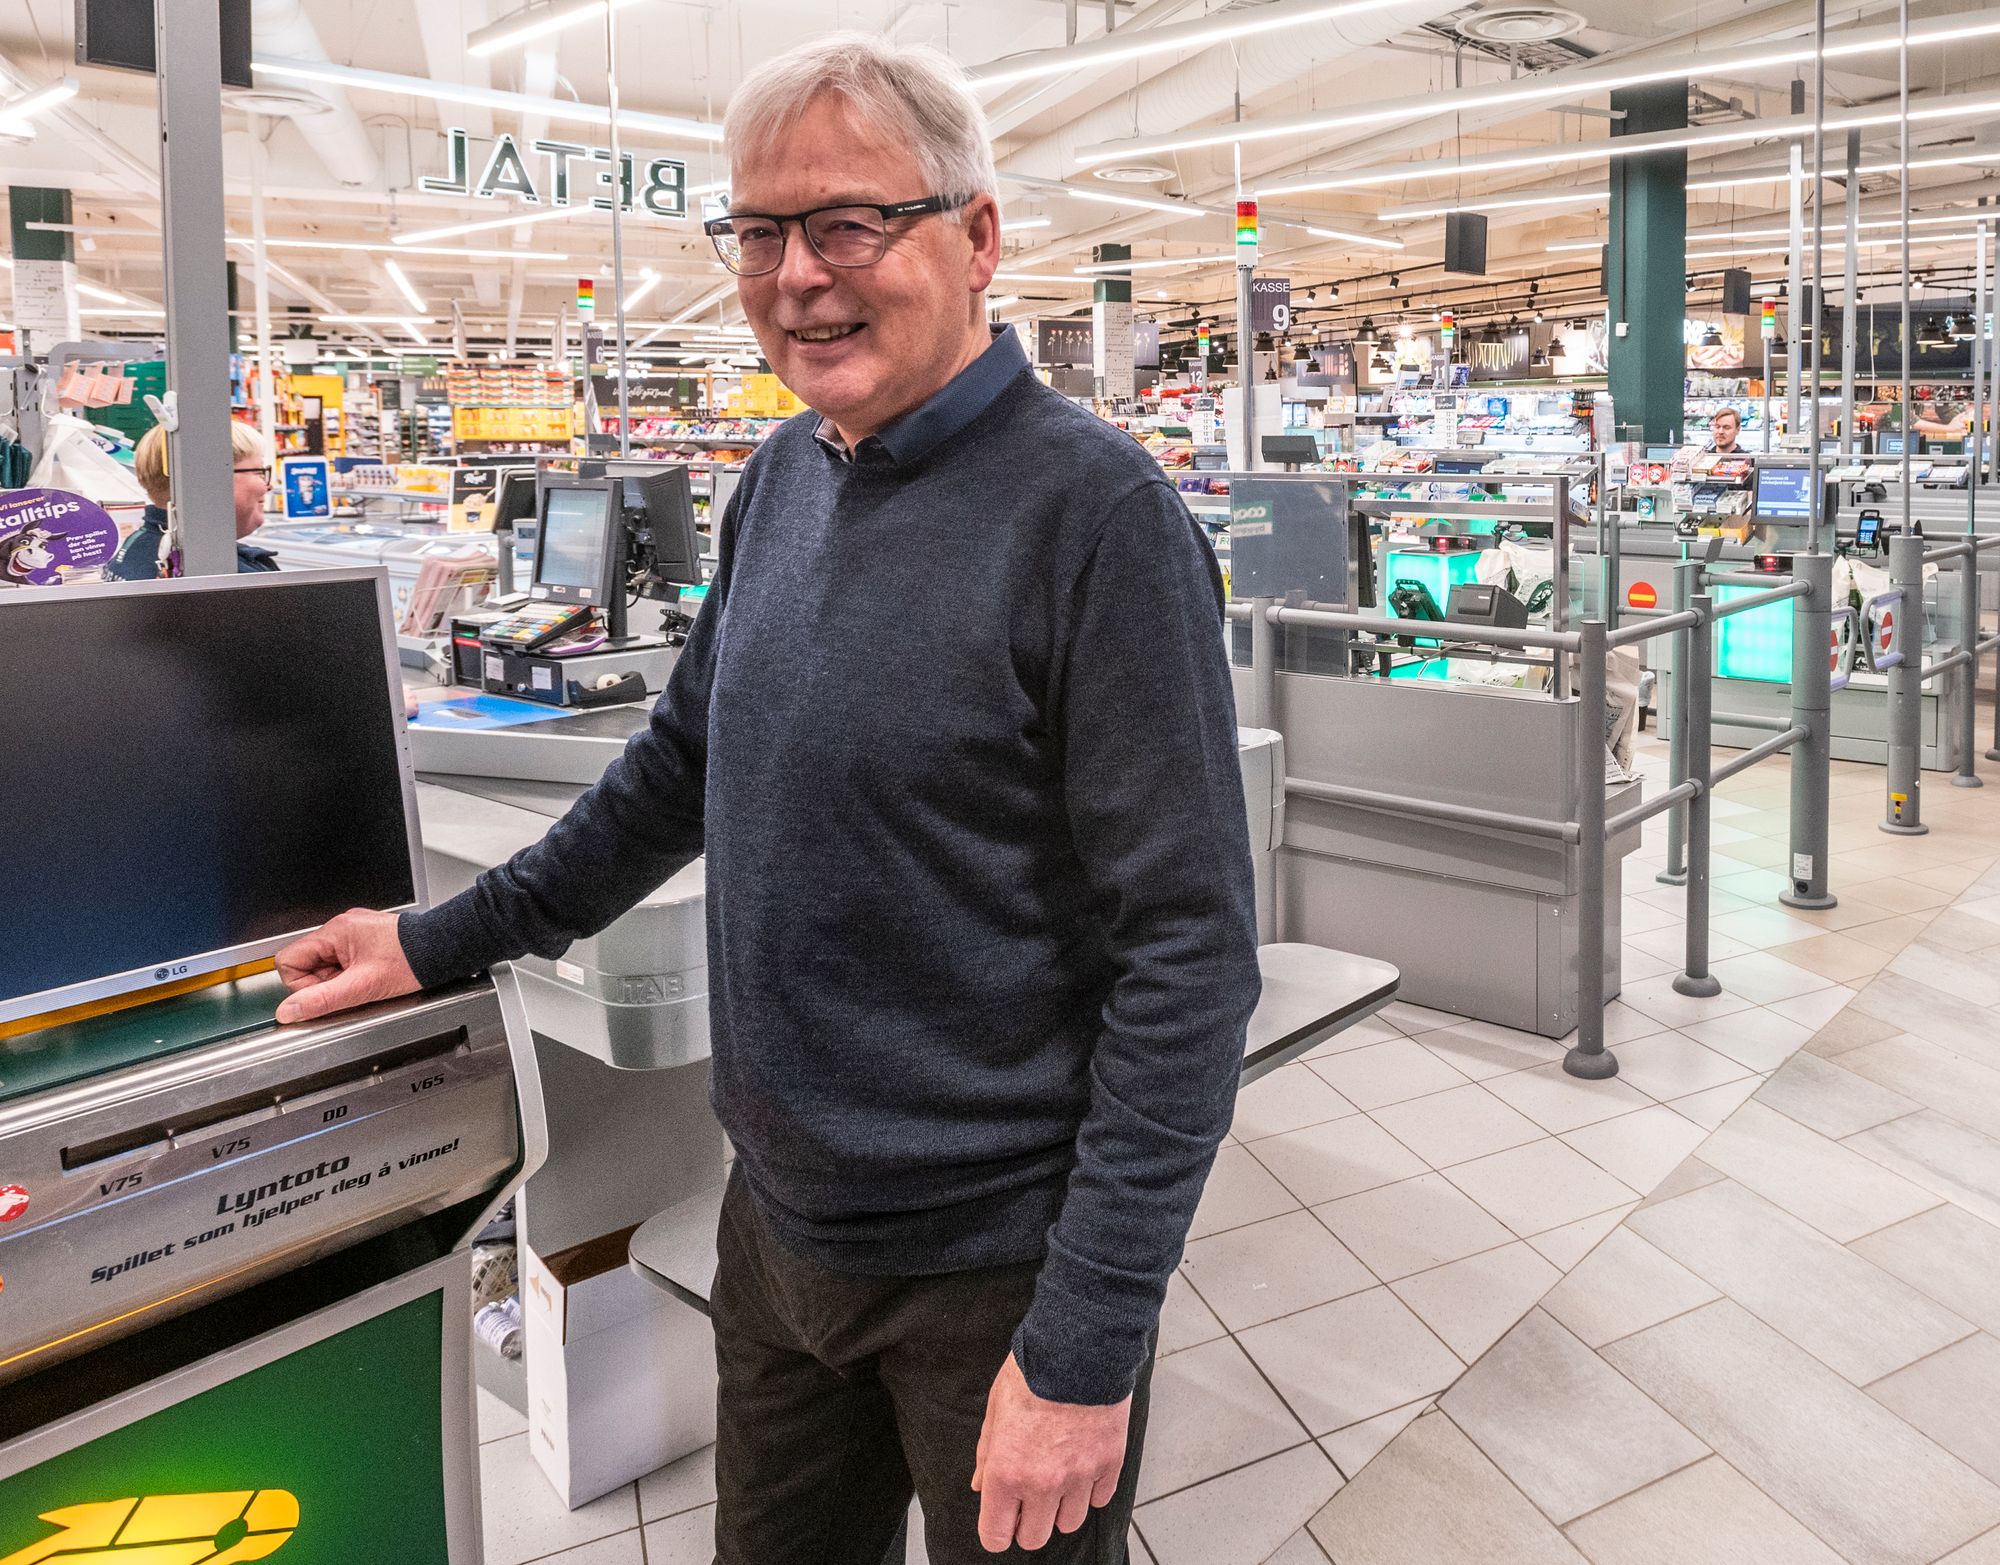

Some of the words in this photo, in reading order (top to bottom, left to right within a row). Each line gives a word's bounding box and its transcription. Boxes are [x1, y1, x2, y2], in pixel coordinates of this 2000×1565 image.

[1252, 282, 1290, 293] KASSE
[1273, 304, 1289, 330] 9
[596, 346, 604, 364] 6
[1190, 370, 1202, 383] 12
[9, 496, 45, 508] lanserer
[85, 530, 107, 540] spillet
[83, 548, 102, 557] hest!
[86, 542, 106, 551] vinne
[171, 964, 188, 976] LG
[411, 1073, 445, 1093] V65
[323, 1105, 348, 1123] DD
[212, 1136, 251, 1159] V75
[100, 1171, 143, 1196] V75
[216, 1154, 350, 1216] Lyntoto
[90, 1243, 174, 1285] Spillet
[184, 1222, 235, 1246] som
[242, 1188, 325, 1233] hjelper
[331, 1172, 372, 1196] deg
[378, 1161, 391, 1178] å
[398, 1137, 460, 1170] vinne!
